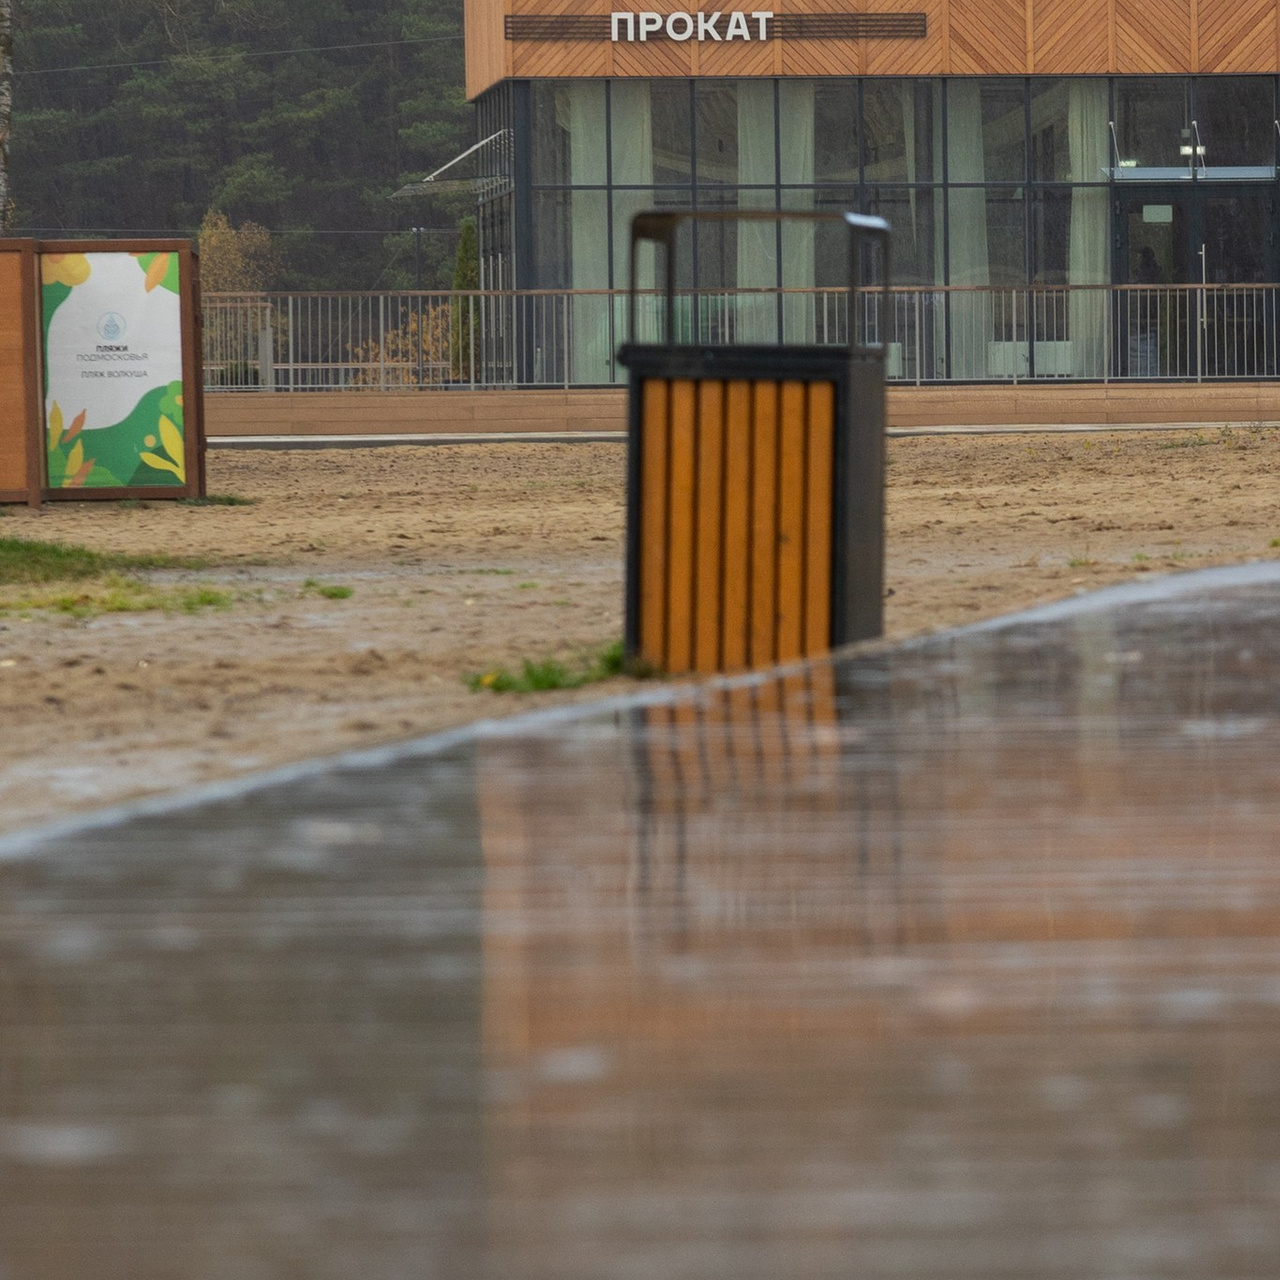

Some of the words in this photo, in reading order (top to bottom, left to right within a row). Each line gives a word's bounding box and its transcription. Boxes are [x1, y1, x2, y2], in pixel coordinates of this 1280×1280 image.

[610, 11, 774, 42] ПРОКАТ
[76, 353, 148, 361] ПОДМОСКОВЬЯ
[81, 370, 105, 378] ПЛЯЖ
